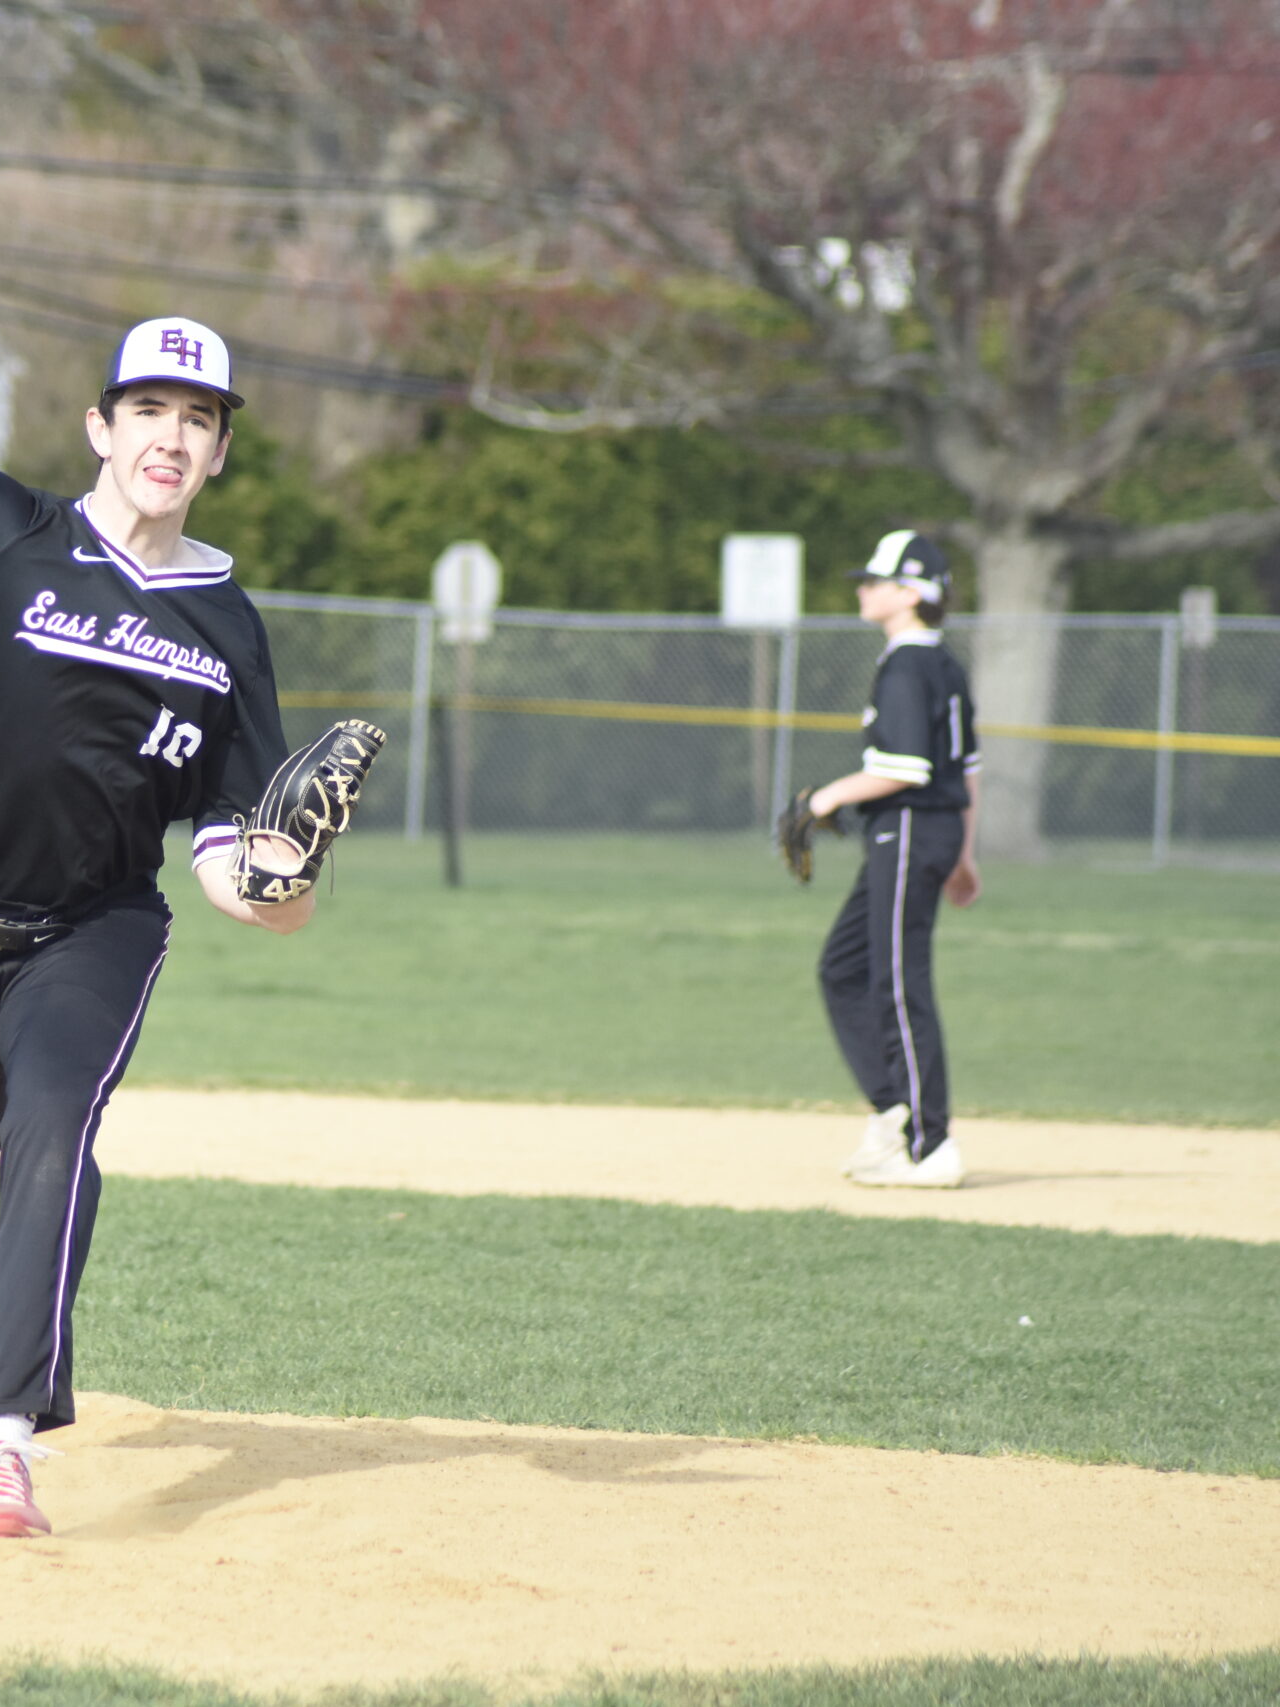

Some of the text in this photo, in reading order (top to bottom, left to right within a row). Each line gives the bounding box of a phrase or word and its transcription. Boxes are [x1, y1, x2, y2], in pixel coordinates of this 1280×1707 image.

[160, 328, 203, 371] EH
[22, 590, 231, 681] East Hampton
